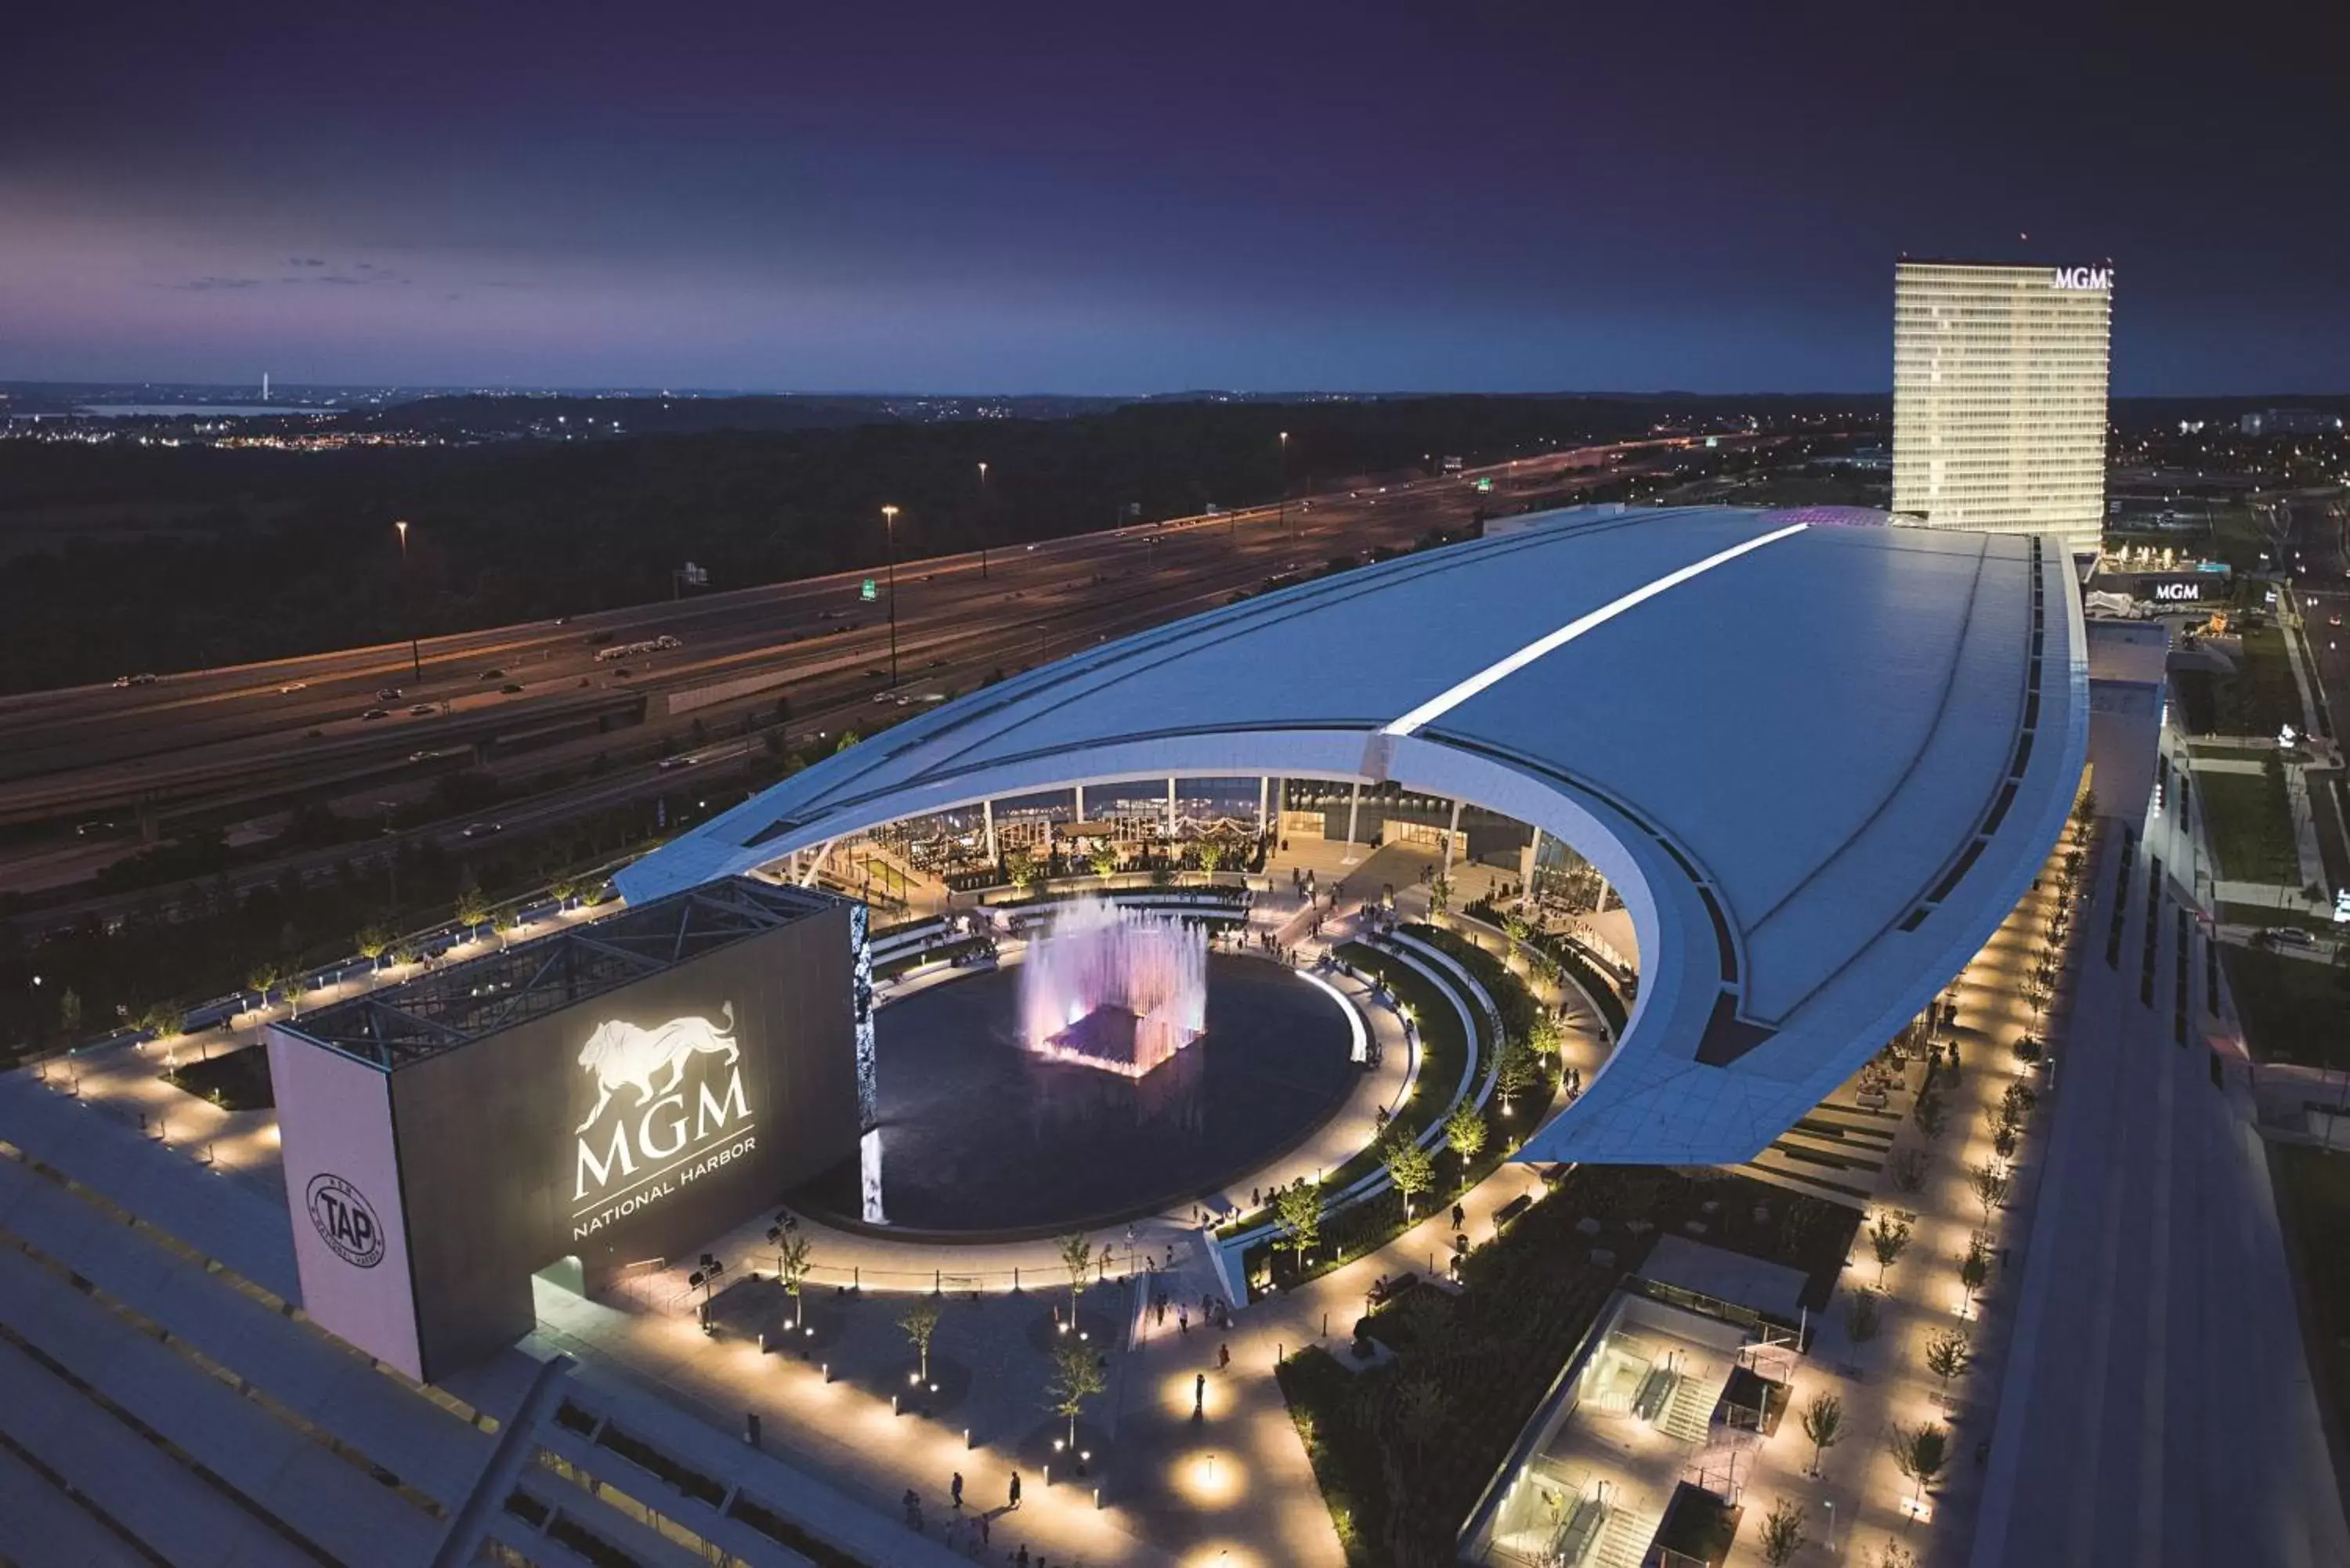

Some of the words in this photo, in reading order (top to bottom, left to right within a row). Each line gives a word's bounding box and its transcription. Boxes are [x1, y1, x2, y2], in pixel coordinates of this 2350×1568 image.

[2053, 266, 2108, 289] MGM
[2155, 583, 2200, 599] MGM
[572, 1065, 753, 1201] MGM
[573, 1182, 675, 1241] NATIONAL
[680, 1137, 756, 1185] HARBOR
[320, 1191, 372, 1251] TAP
